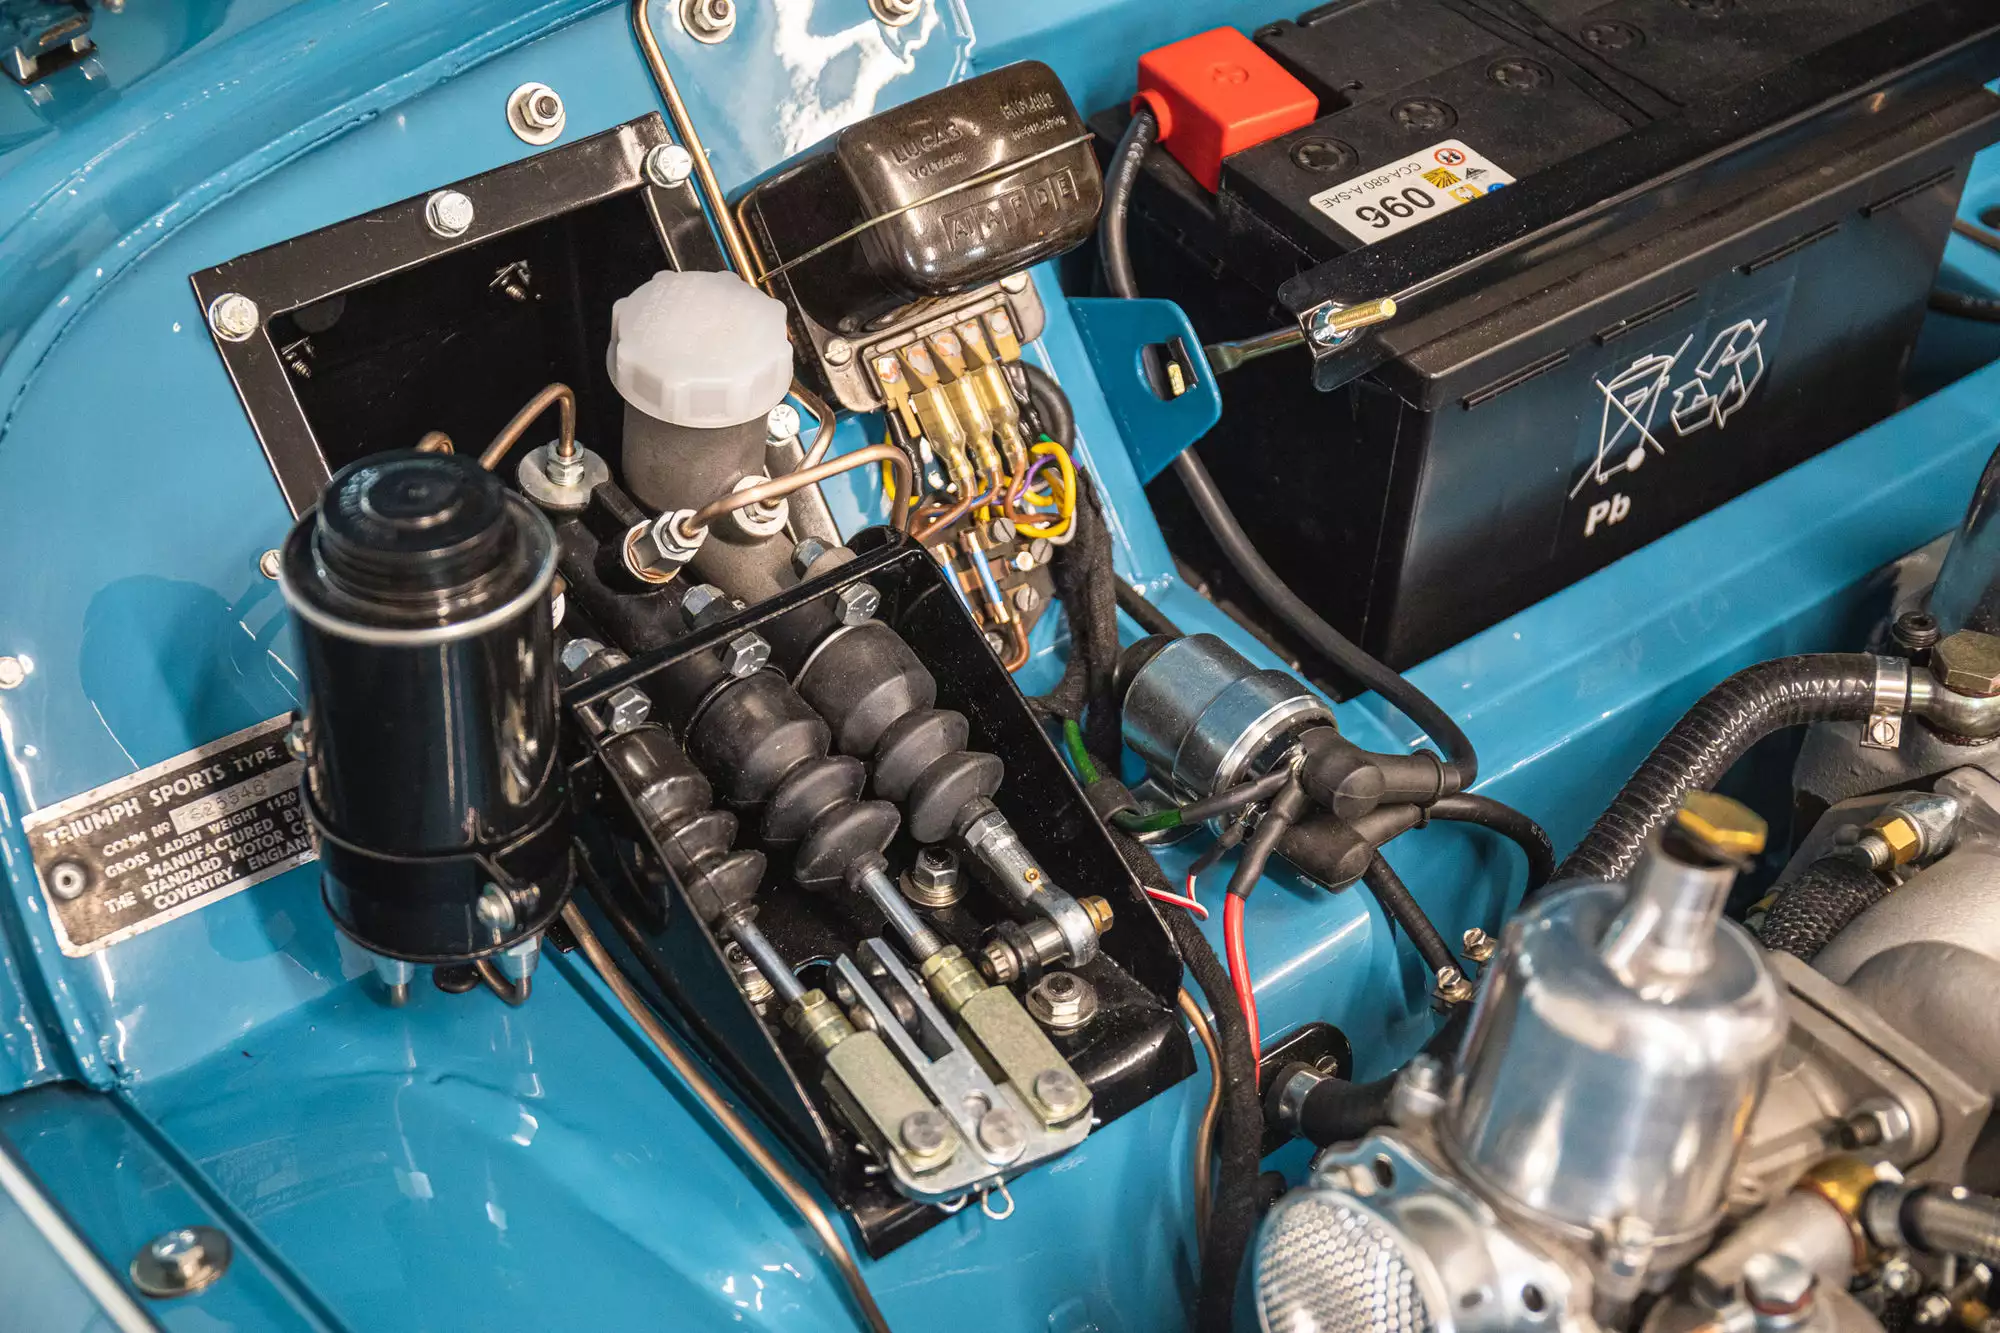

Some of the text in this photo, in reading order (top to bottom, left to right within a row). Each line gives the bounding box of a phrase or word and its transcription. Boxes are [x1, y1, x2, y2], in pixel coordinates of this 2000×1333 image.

[890, 121, 963, 166] LUCAS
[1009, 195, 1022, 219] F
[1034, 188, 1049, 206] D
[1057, 177, 1071, 198] E
[1355, 187, 1436, 229] 096
[1584, 492, 1631, 537] Pb
[43, 797, 143, 847] TRIUMPH
[148, 764, 226, 807] SPORTS
[104, 851, 150, 878] GROSS
[155, 830, 202, 858] LADEN
[207, 806, 259, 835] WEIGHT
[145, 804, 304, 881] MANUFACTURED BY
[104, 891, 138, 914] THE
[141, 855, 223, 902] STANDARD
[229, 829, 285, 863] MOTOR
